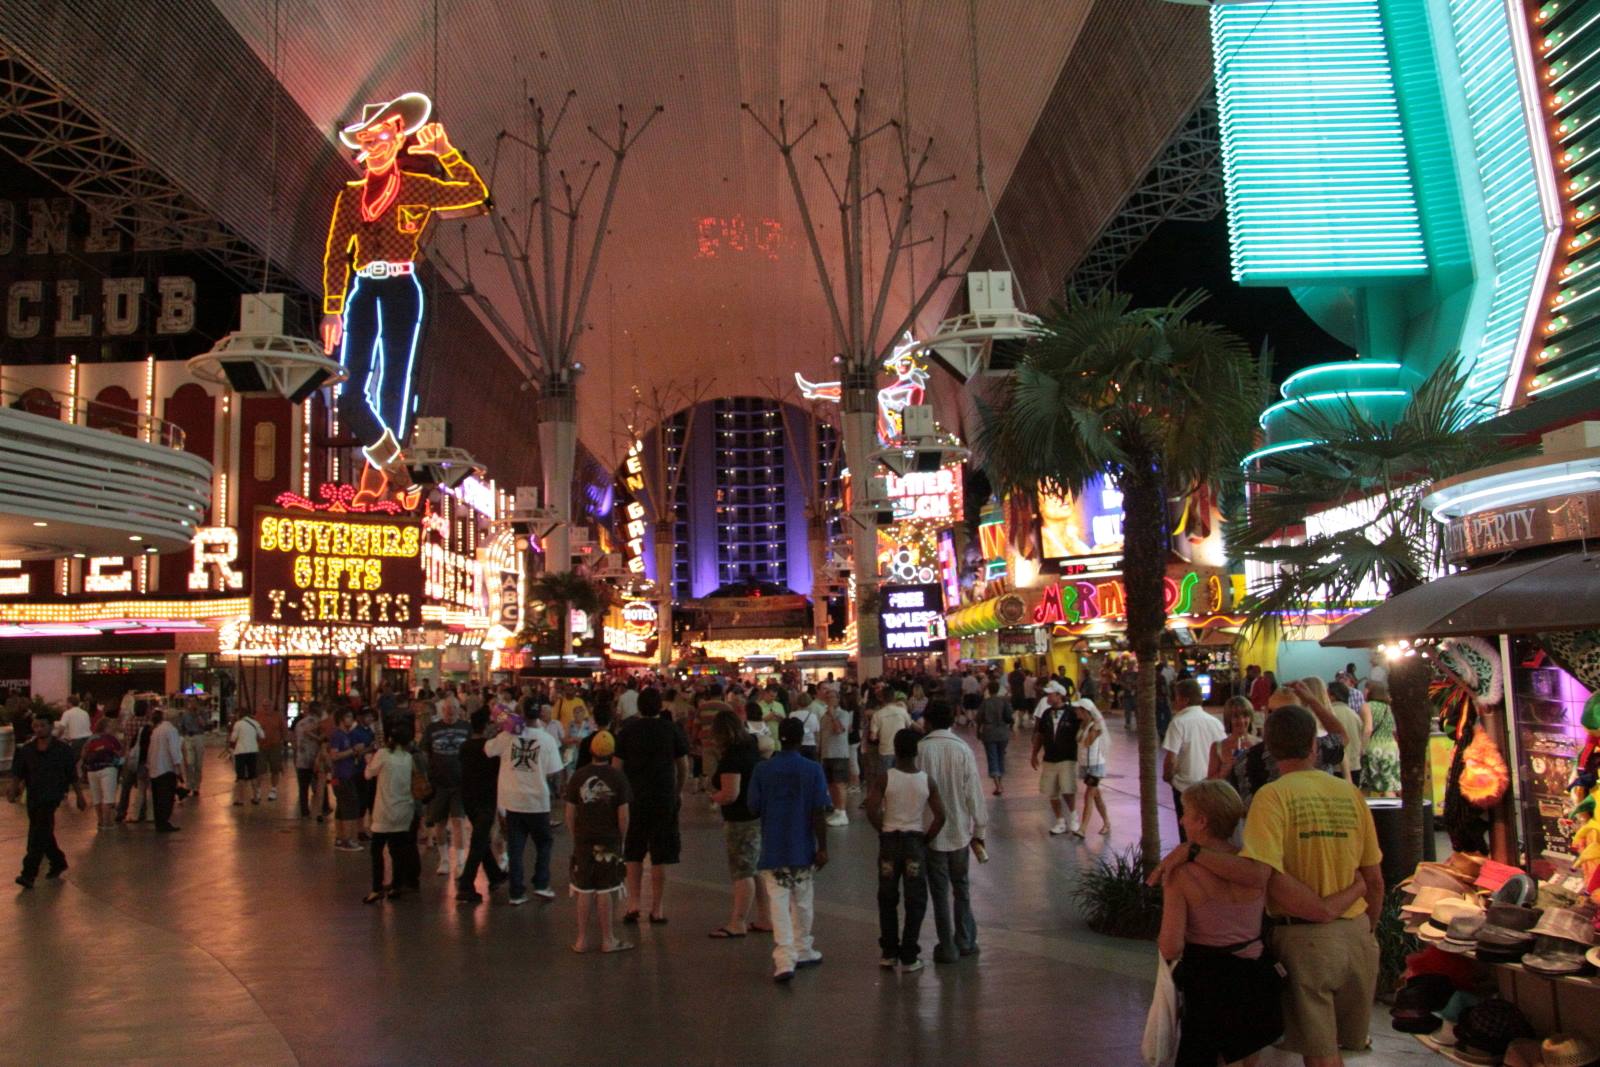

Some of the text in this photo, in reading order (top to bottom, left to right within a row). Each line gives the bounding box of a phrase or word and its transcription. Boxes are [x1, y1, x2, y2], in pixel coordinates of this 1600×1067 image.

[6, 275, 197, 338] CLUB
[259, 516, 420, 558] SOUVENIRS
[1473, 508, 1536, 549] PARTY
[294, 555, 382, 591] GIFTS
[267, 588, 412, 622] T-SHIRTS
[1034, 571, 1199, 625] MERMDS
[886, 631, 930, 648] PARTY
